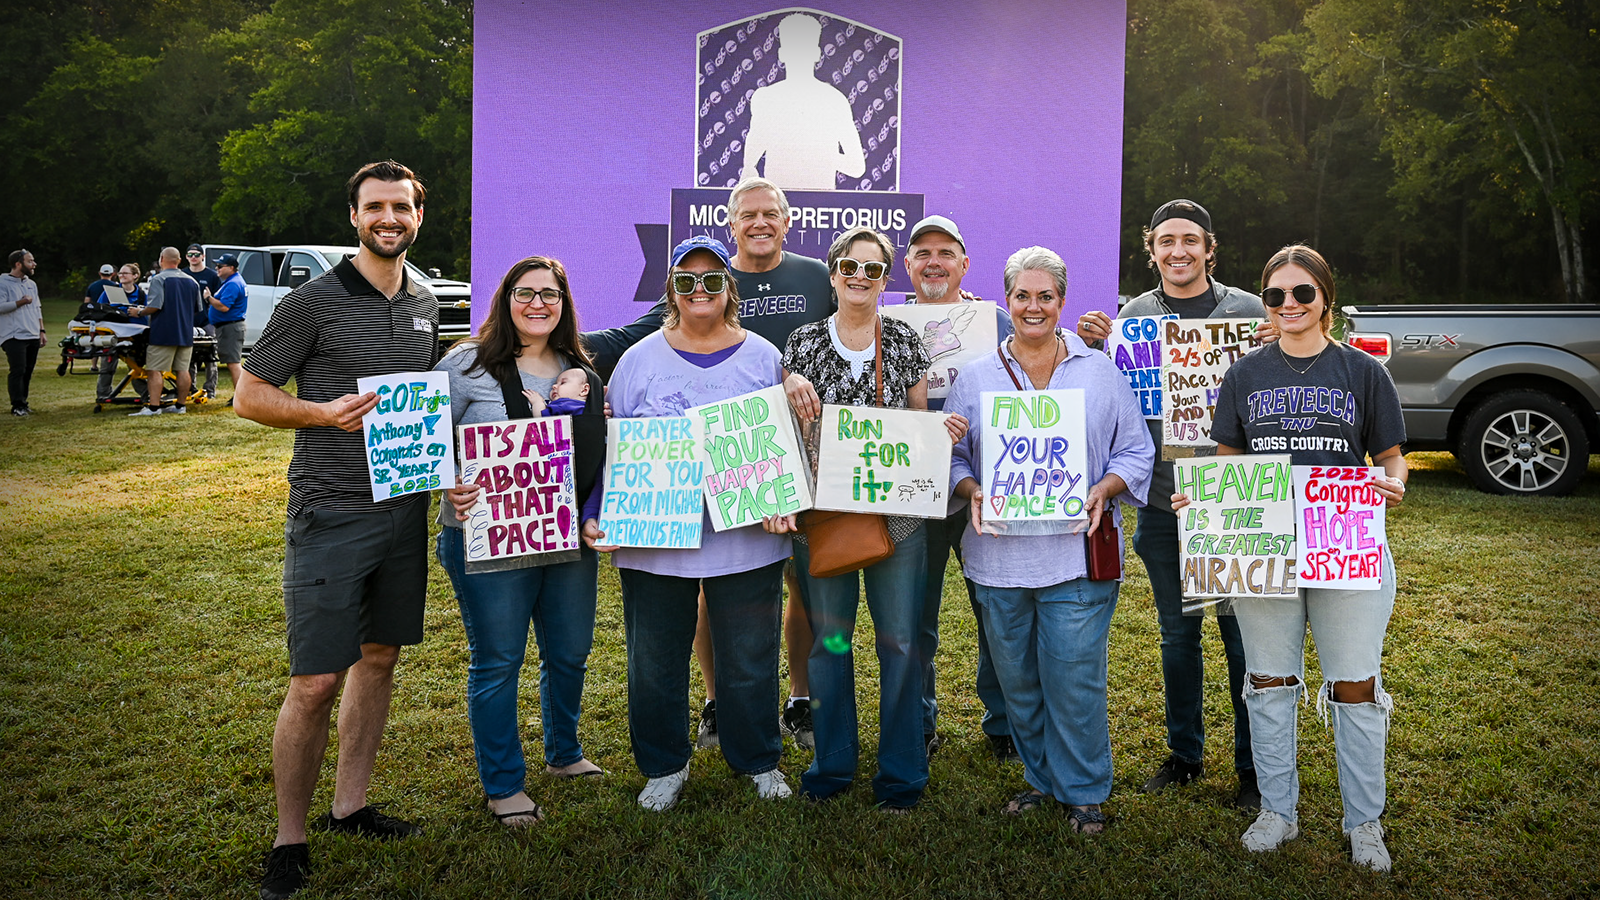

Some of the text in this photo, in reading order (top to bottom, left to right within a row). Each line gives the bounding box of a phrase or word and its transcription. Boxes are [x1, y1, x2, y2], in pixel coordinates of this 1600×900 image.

[789, 207, 906, 231] PRETORIUS
[738, 295, 806, 318] REVECCA
[1122, 318, 1158, 342] GO
[1400, 333, 1461, 346] STX
[1169, 347, 1200, 368] 2/3
[376, 383, 409, 415] GO
[991, 395, 1061, 430] FIND
[1248, 386, 1355, 426] TREVECCA
[620, 418, 694, 442] PRAYER
[699, 396, 769, 434] FIND
[1280, 417, 1318, 432] TNU
[464, 418, 570, 460] IT'S ALL
[1172, 422, 1198, 442] 1/3
[1252, 436, 1349, 452] CROSS COUNTRY
[617, 440, 696, 462] POWER
[704, 425, 787, 474] YOUR
[994, 434, 1069, 470] YOUR
[390, 475, 440, 497] 2025
[474, 456, 570, 494] ABOUT
[610, 460, 704, 488] FOR YOU
[706, 456, 784, 496] HAPPY
[990, 468, 1082, 504] HAPPY
[1178, 462, 1291, 503] HEAVEN
[1309, 467, 1370, 481] 2025
[486, 485, 560, 520] THAT
[604, 489, 702, 516] FROM MICHAEL
[716, 472, 800, 528] PACE
[1002, 494, 1057, 518] PACE
[488, 505, 571, 556] PACE!
[1185, 507, 1264, 531] IS THE
[1304, 506, 1376, 550] HOPE
[1187, 532, 1296, 556] GREATEST
[1183, 557, 1296, 594] MIRACLE
[1334, 544, 1383, 584] YEAR!
